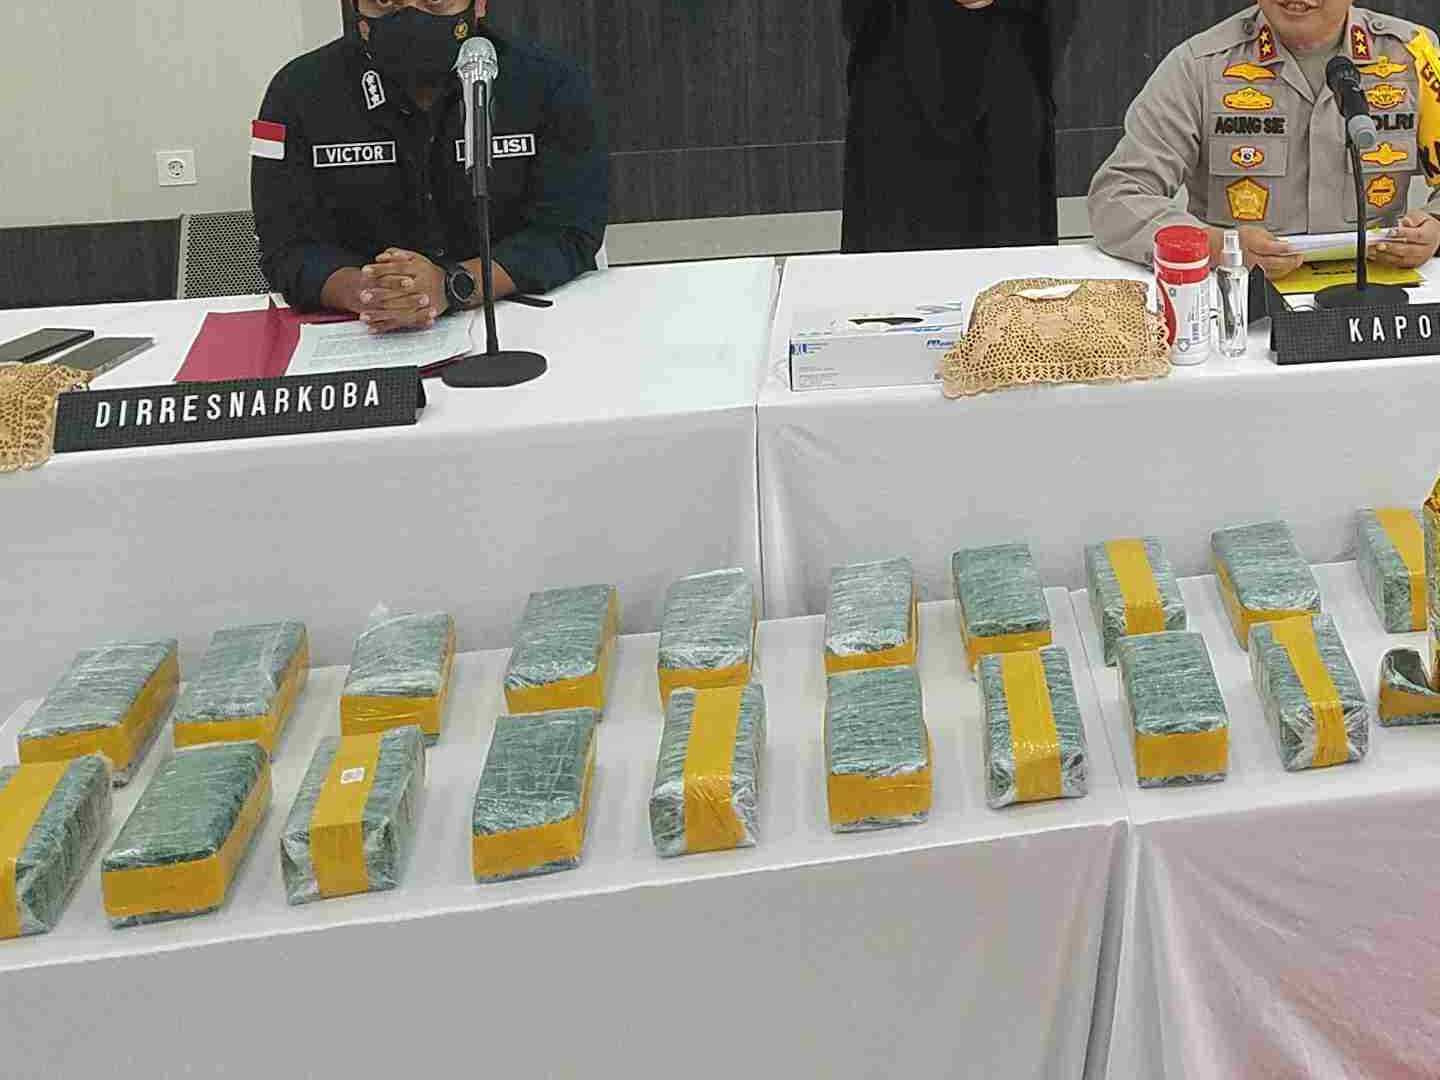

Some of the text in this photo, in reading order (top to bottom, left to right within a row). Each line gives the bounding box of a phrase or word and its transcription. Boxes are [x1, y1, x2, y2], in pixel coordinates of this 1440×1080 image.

[1214, 116, 1261, 134] AGUNG
[1373, 113, 1414, 131] OLRI
[326, 145, 384, 163] VICTOR
[95, 379, 381, 428] DIRRESNARKOBA
